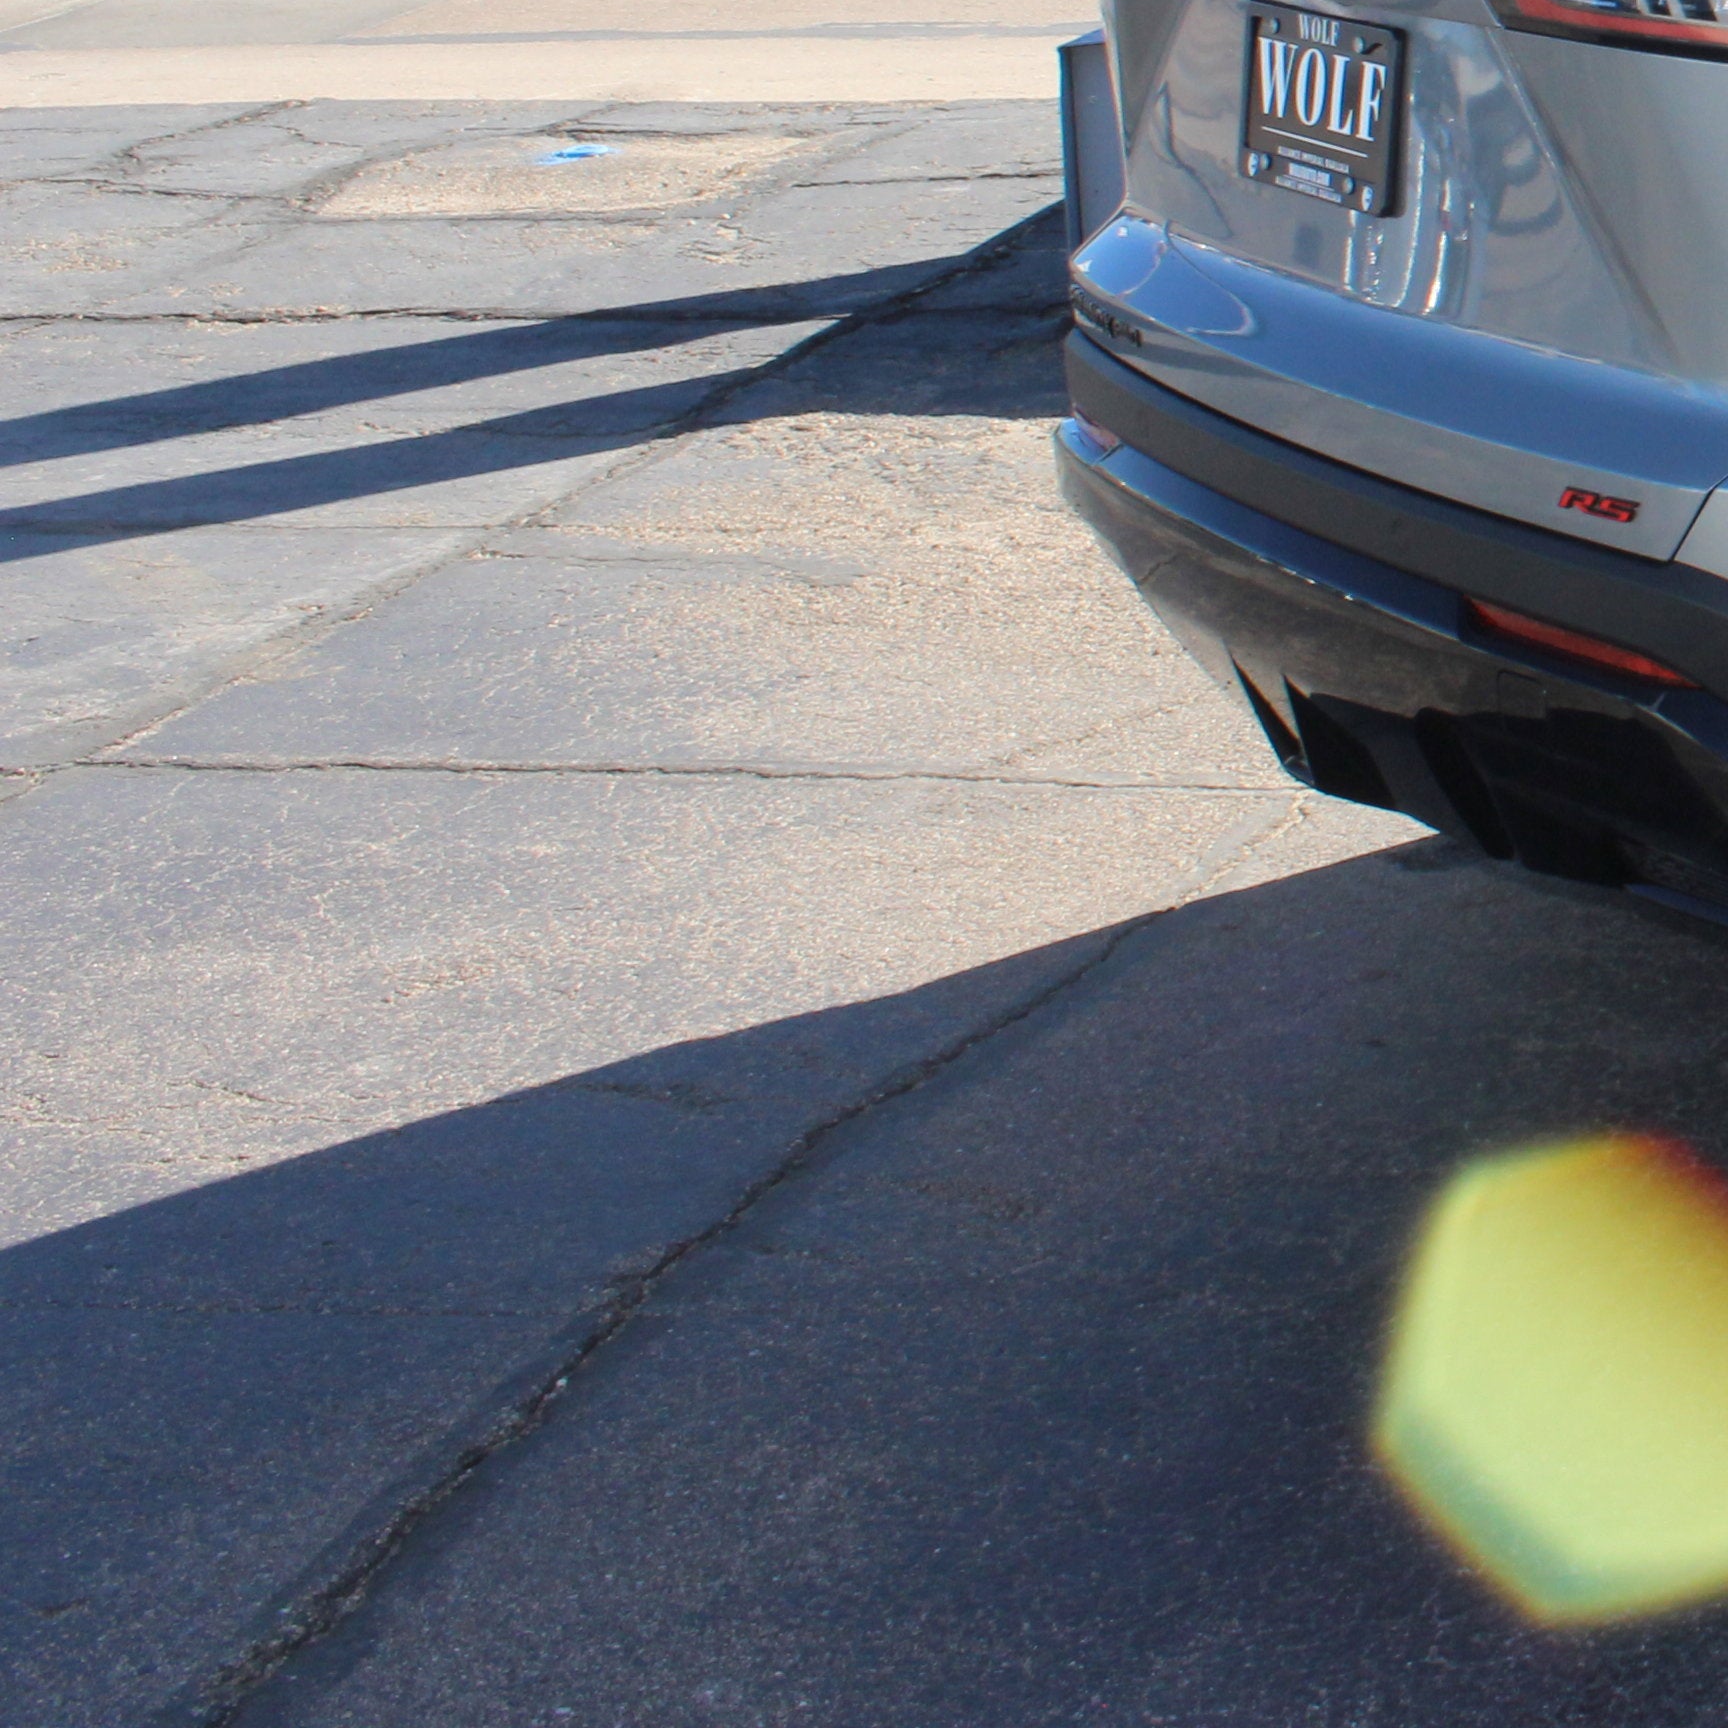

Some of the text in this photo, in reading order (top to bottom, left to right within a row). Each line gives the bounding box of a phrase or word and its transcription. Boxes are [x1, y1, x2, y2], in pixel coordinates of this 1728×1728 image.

[1298, 13, 1340, 47] WOLF
[1257, 36, 1388, 142] WOLF
[1558, 486, 1642, 523] RS
